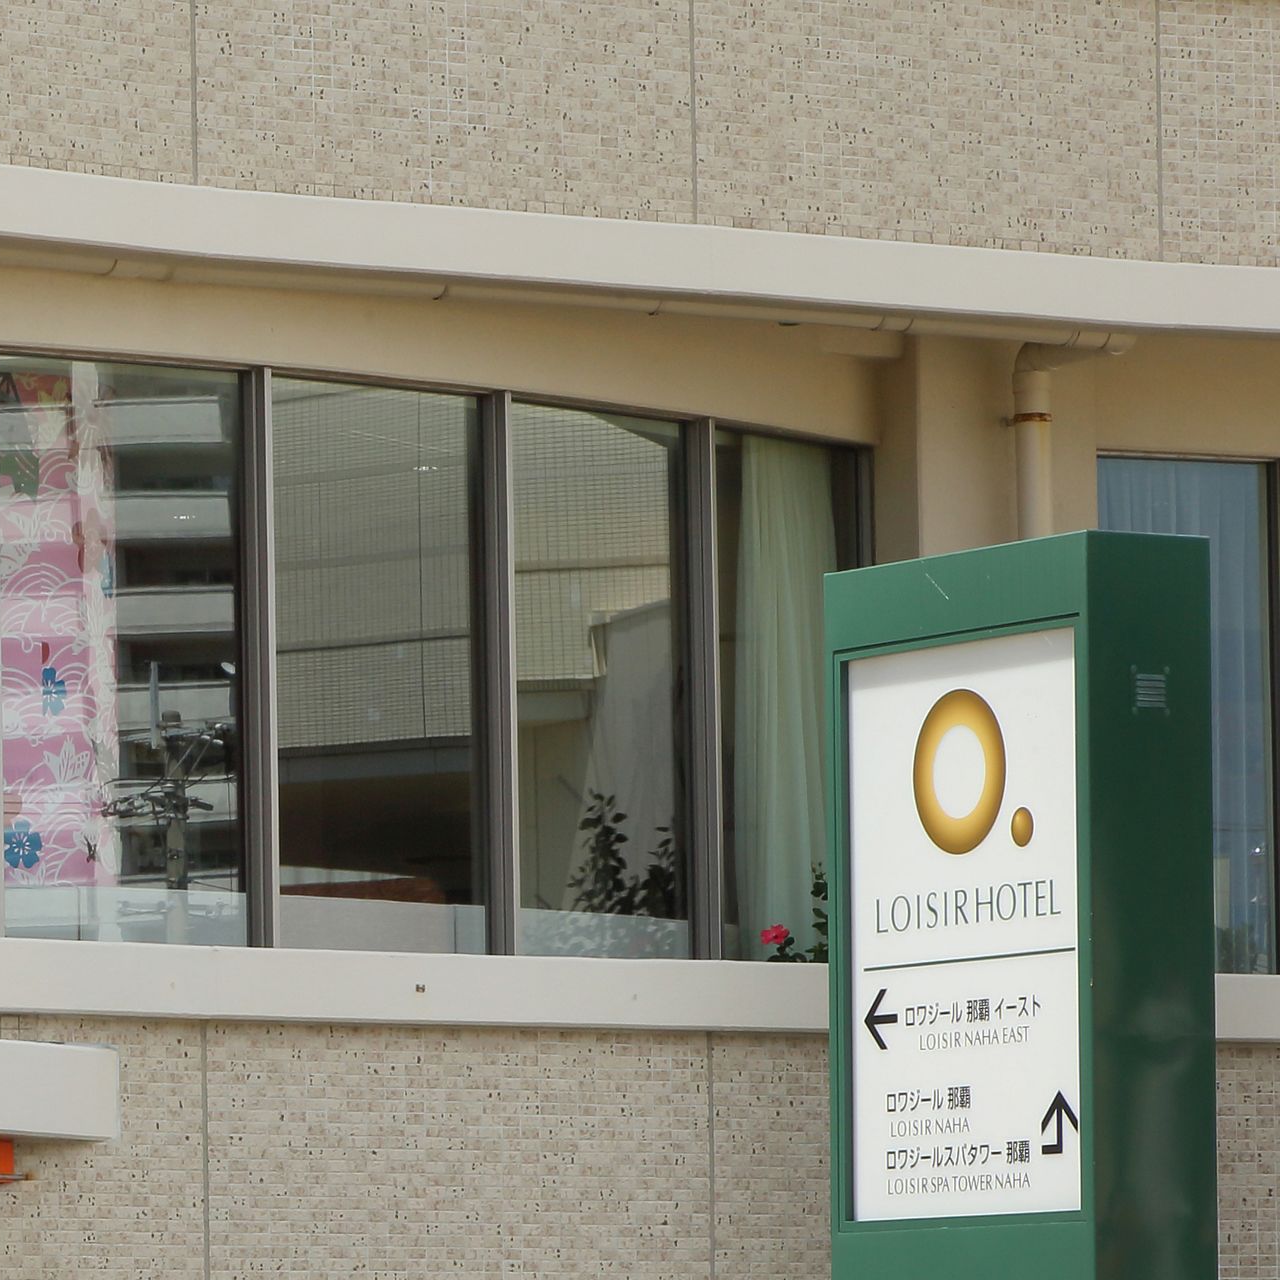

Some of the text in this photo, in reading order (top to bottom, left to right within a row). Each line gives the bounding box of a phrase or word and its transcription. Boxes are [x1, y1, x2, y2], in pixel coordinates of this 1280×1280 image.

[905, 994, 1041, 1027] ロワジール 那覇 イースト
[919, 1025, 1030, 1051] LOISIR NAHA EAST
[886, 1086, 971, 1113] ロワジール 那覇
[890, 1116, 970, 1138] LOISIR NAHA
[1006, 1140, 1030, 1164] 那覇
[887, 1172, 1031, 1195] LOISIR SPA TOWER NAHA
